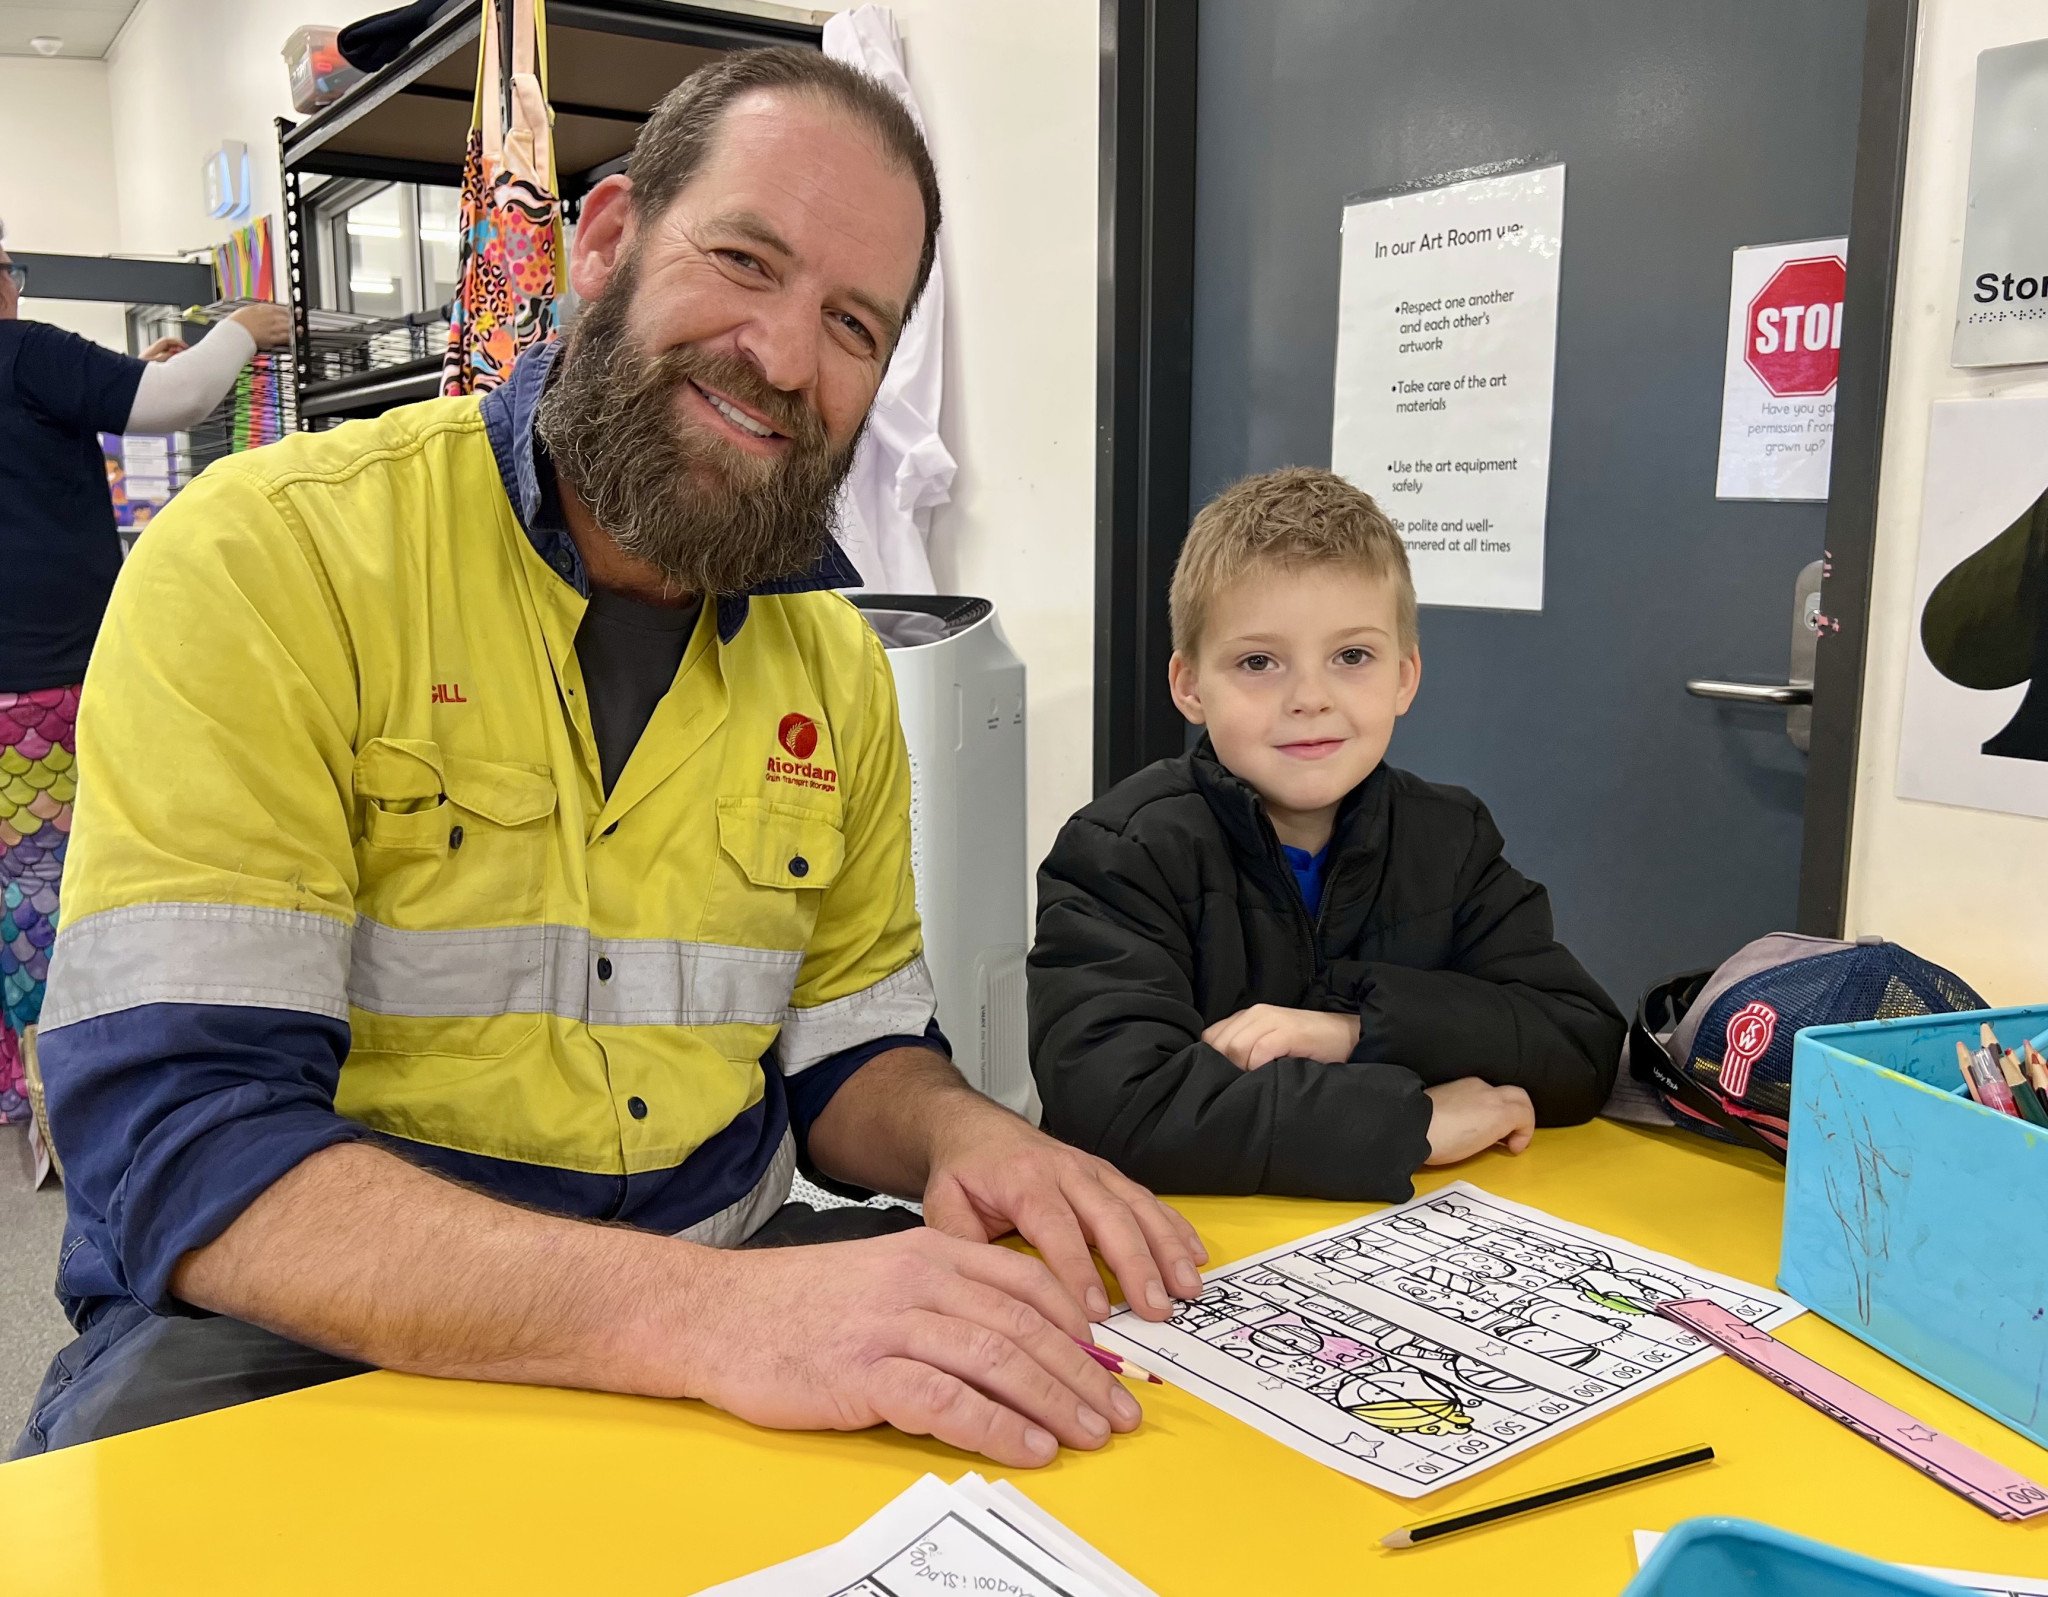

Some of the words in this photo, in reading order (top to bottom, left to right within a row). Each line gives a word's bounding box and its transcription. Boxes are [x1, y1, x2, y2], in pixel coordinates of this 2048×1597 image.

[1375, 241, 1388, 259] In
[1391, 240, 1416, 256] our
[1419, 233, 1443, 252] Art
[1447, 227, 1492, 248] Room
[1400, 297, 1442, 315] Respect
[1444, 297, 1466, 309] one
[1468, 289, 1515, 305] another
[1399, 319, 1422, 335] and
[1424, 314, 1451, 332] each
[1453, 311, 1490, 328] other's
[1398, 336, 1443, 354] artwork
[1397, 379, 1425, 395] Take
[1427, 379, 1451, 392] care
[1453, 375, 1466, 389] of
[1467, 374, 1487, 389] the
[1489, 373, 1507, 387] art
[1396, 397, 1447, 414] materials
[1761, 403, 1790, 415] Have
[1793, 404, 1815, 417] you
[1818, 404, 1835, 418] go
[1747, 424, 1804, 437] permission
[1765, 441, 1801, 456] grown
[1804, 438, 1826, 456] up?
[1393, 461, 1412, 474] Use
[1415, 459, 1433, 474] the
[1435, 460, 1452, 472] art
[1454, 457, 1518, 474] equipment
[1392, 479, 1423, 495] safely
[1407, 519, 1438, 533] polite
[1441, 519, 1463, 532] and
[1465, 518, 1494, 532] well-
[1404, 538, 1446, 551] nnered
[1448, 540, 1461, 551] at
[1463, 539, 1477, 551] all
[1480, 539, 1511, 552] times
[767, 756, 836, 783] Riordan
[1736, 1303, 1763, 1317] 20
[1642, 1349, 1673, 1363] 30
[1612, 1365, 1642, 1380] 80
[1573, 1382, 1609, 1399] 100
[1538, 1401, 1570, 1415] 90
[1493, 1421, 1527, 1436] 50
[1456, 1439, 1490, 1455] 60
[1415, 1461, 1445, 1475] 10
